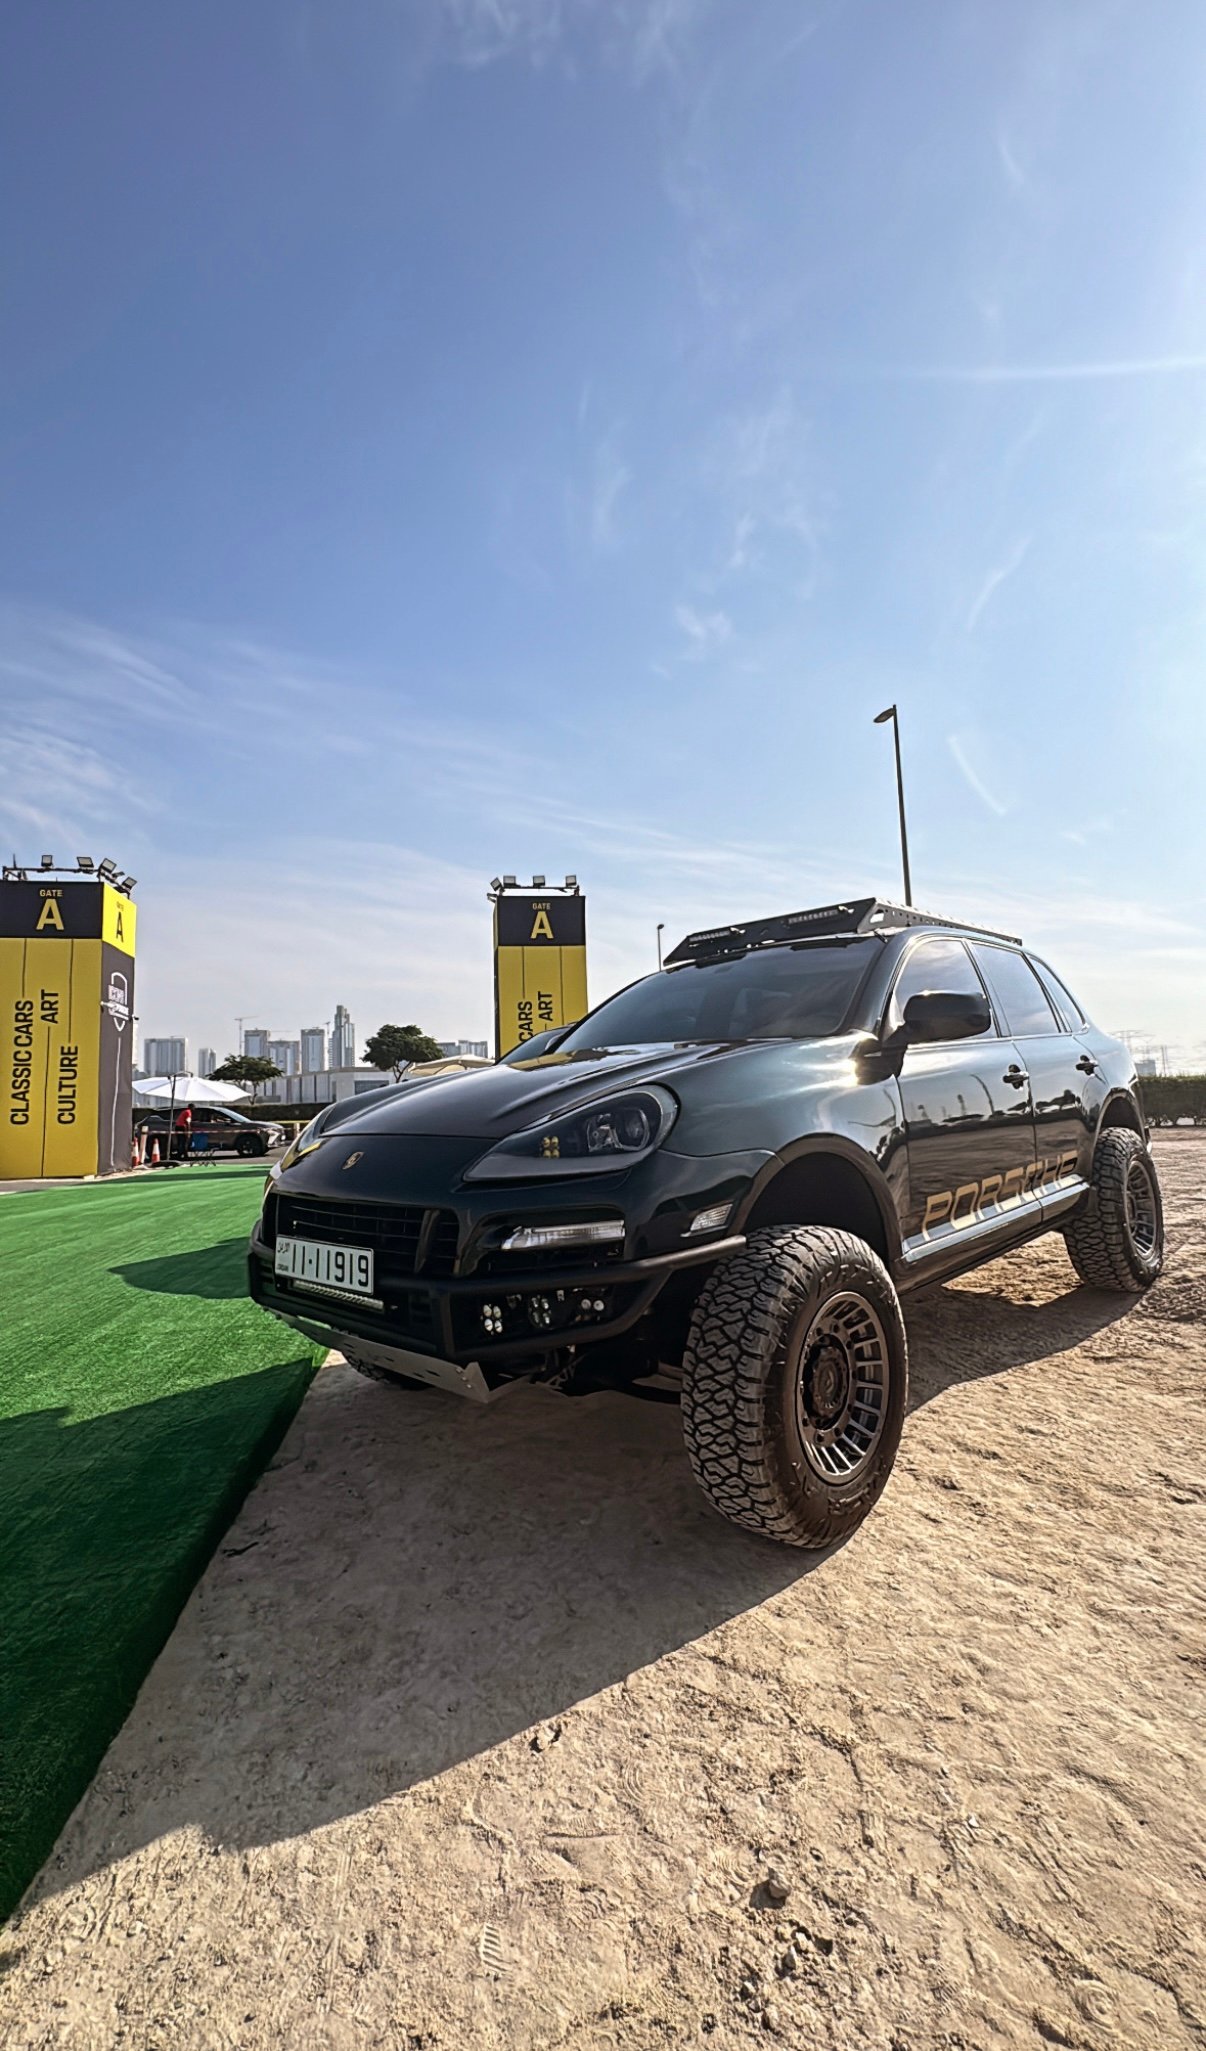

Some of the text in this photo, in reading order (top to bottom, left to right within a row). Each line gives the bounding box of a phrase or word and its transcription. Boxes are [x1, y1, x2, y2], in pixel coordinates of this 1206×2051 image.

[39, 889, 63, 897] GATE
[532, 902, 551, 911] GATE
[36, 898, 65, 930] A
[116, 911, 124, 943] A
[530, 911, 554, 939] A
[40, 989, 59, 1024] ART
[518, 1001, 534, 1043] CARS
[537, 991, 553, 1022] ART
[10, 1000, 34, 1126] CLASSIC CARS
[57, 1045, 78, 1125] CULTURE
